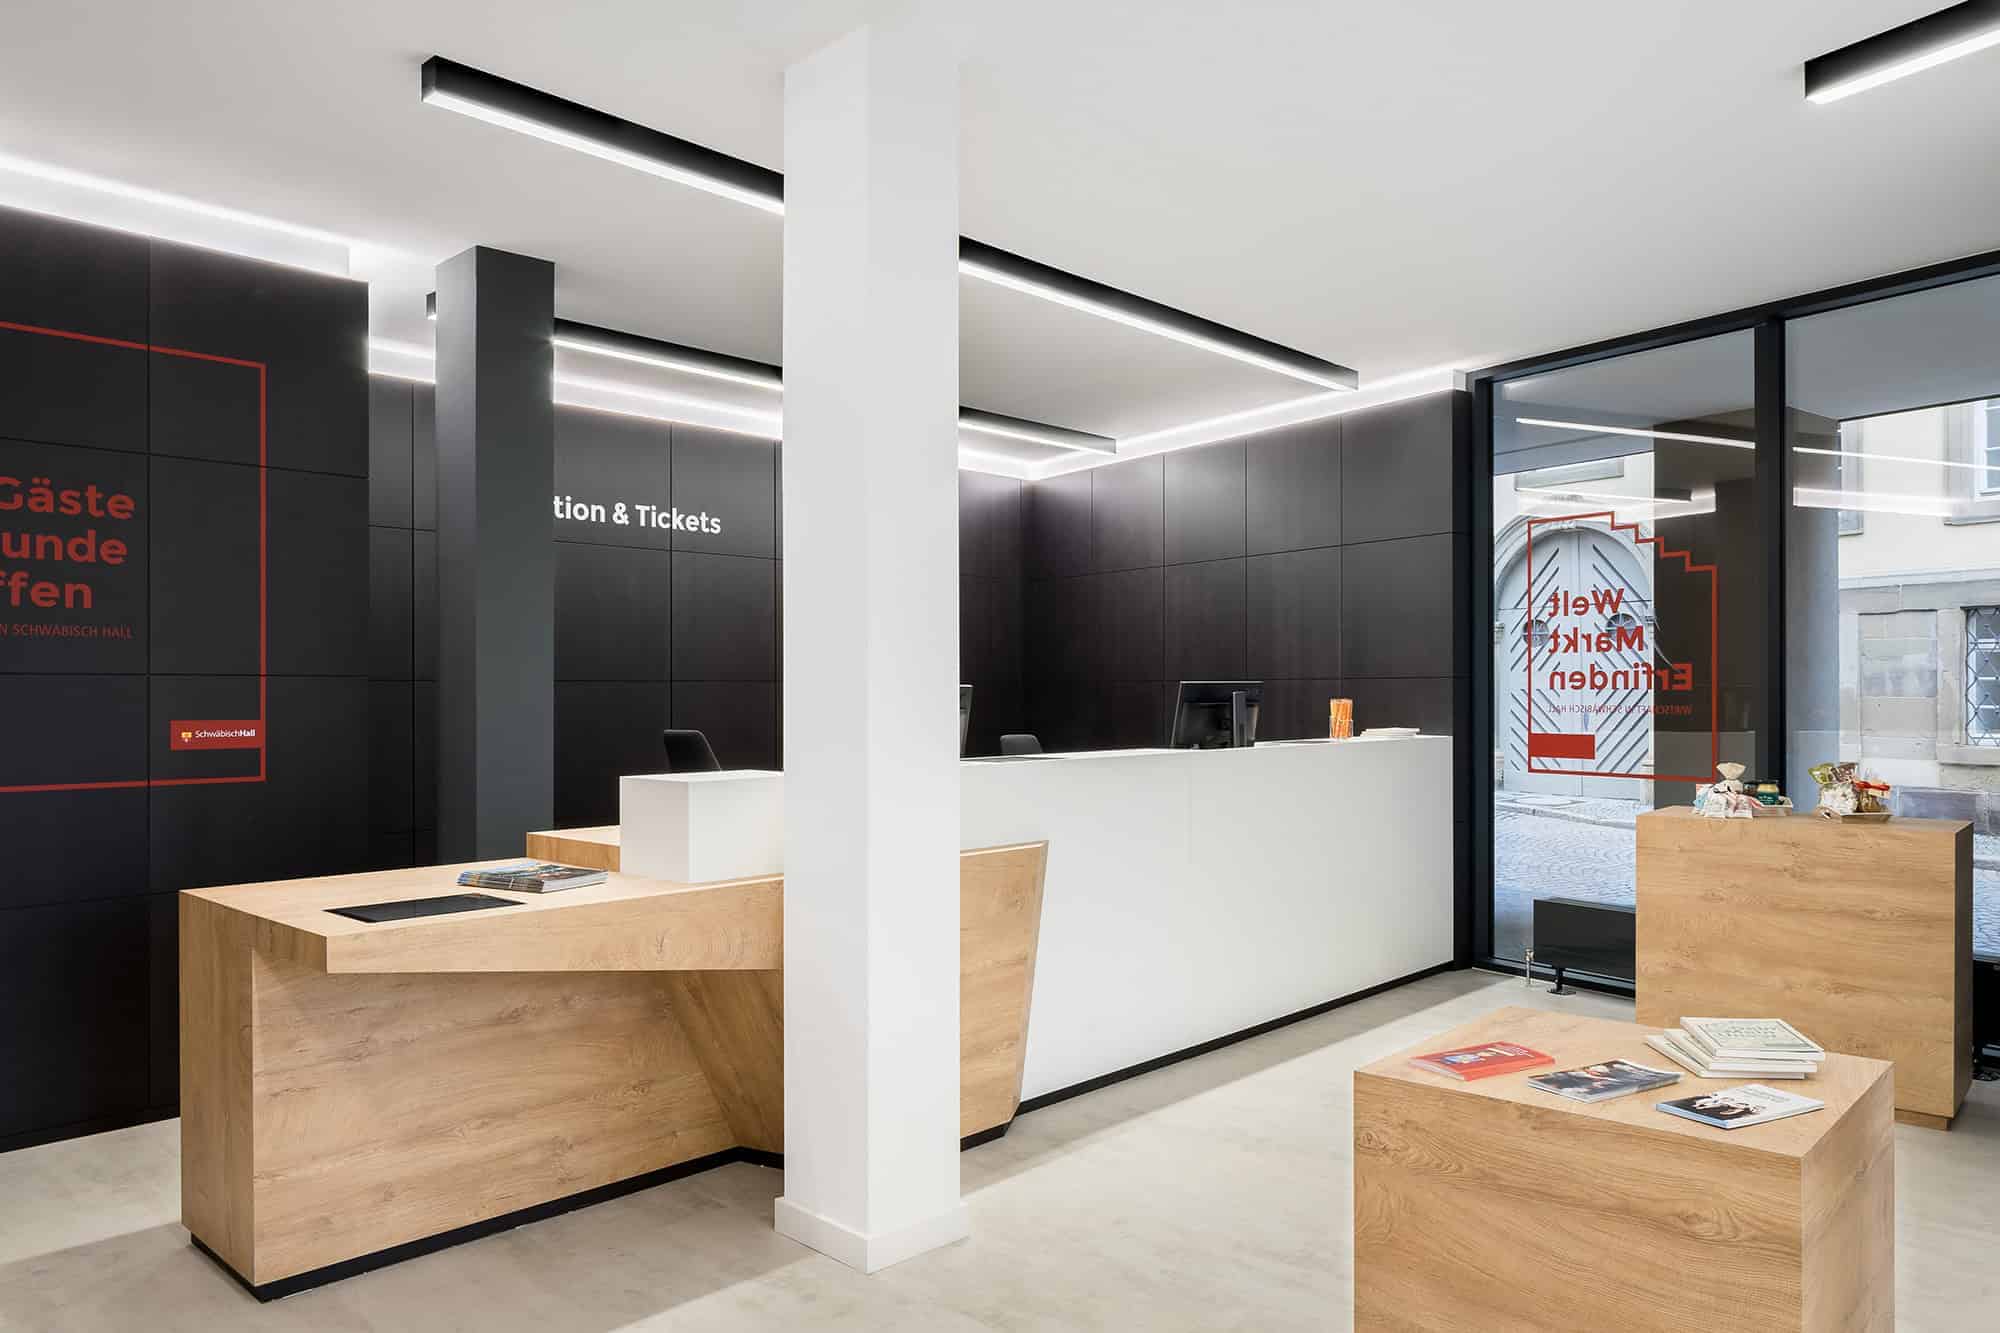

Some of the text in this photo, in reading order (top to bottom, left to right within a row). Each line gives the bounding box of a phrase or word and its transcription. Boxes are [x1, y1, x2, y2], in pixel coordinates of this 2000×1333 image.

[0, 476, 136, 520] Gäste
[553, 495, 721, 534] tion & Tickets
[1, 529, 128, 565] unde
[0, 570, 92, 609] fen
